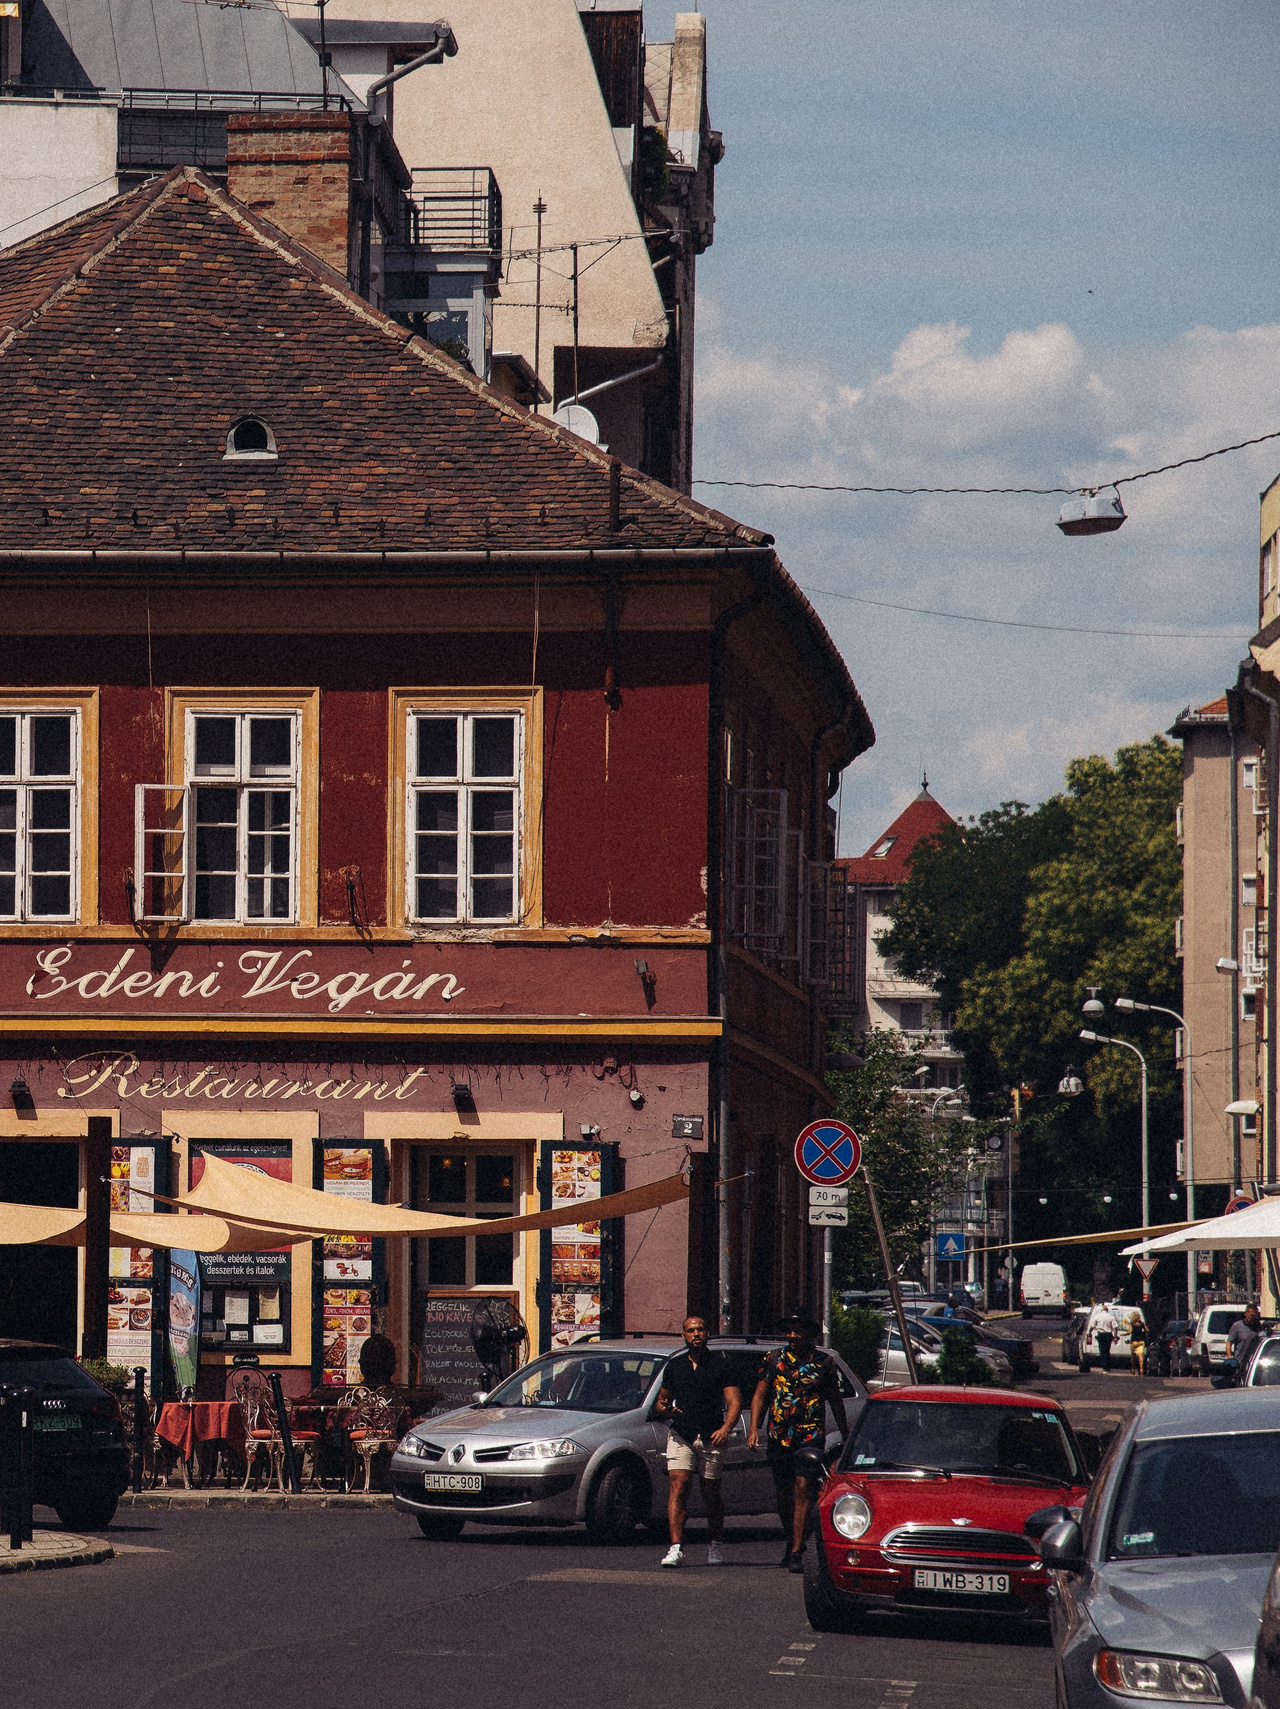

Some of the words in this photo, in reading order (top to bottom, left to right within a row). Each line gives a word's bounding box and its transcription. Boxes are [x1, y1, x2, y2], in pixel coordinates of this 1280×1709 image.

[238, 949, 466, 1013] Vegán
[57, 1050, 431, 1100] Restaurant
[683, 1121, 693, 1134] 2
[816, 1191, 828, 1201] 70
[227, 1254, 255, 1264] ebédek,
[256, 1254, 287, 1264] vacsorák
[207, 1266, 244, 1275] desszertek
[246, 1266, 254, 1275] és
[255, 1266, 275, 1275] italok
[433, 1475, 480, 1489] HTC-908
[932, 1572, 1007, 1592] IWB-319
